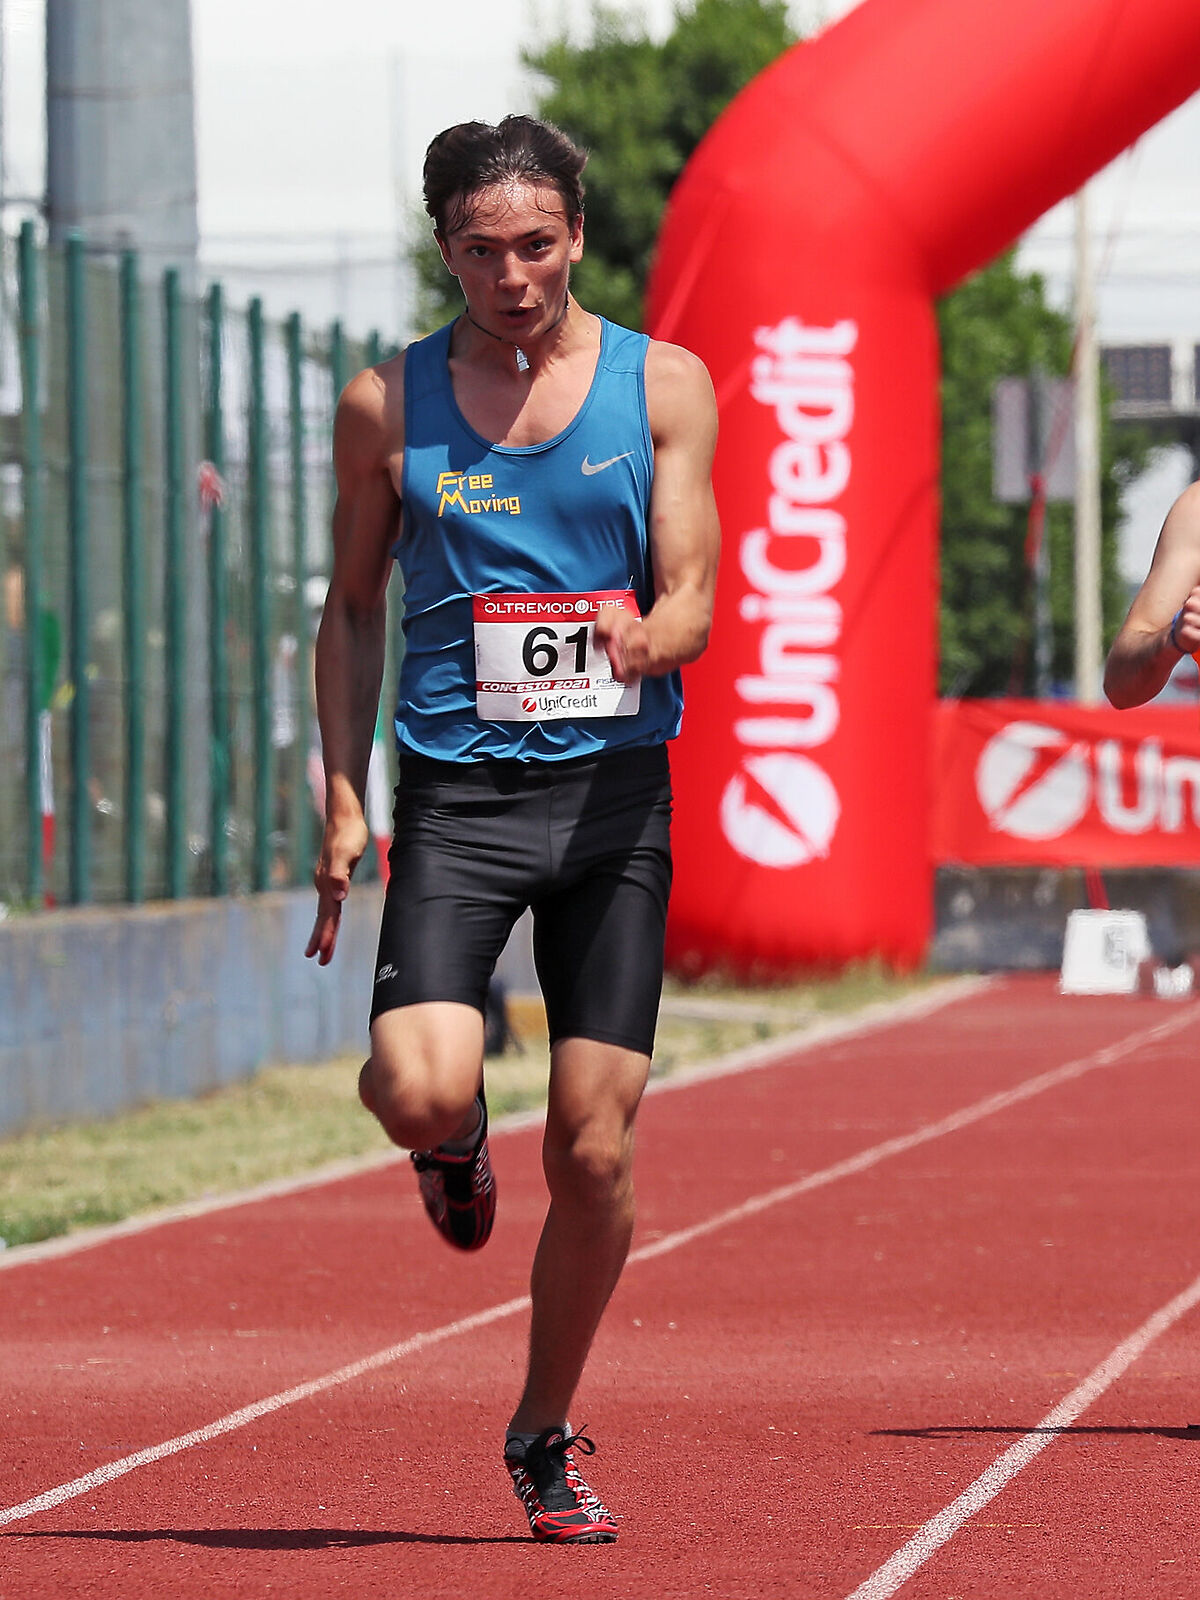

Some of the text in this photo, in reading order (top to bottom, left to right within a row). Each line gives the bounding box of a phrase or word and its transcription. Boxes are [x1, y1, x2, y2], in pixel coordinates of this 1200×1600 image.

[436, 471, 494, 494] Free
[437, 489, 521, 517] Moving
[734, 315, 859, 749] UniCredit
[522, 626, 588, 677] 61
[482, 681, 550, 692] CONCESIO
[553, 680, 588, 691] 2021
[539, 694, 597, 711] UniCredit
